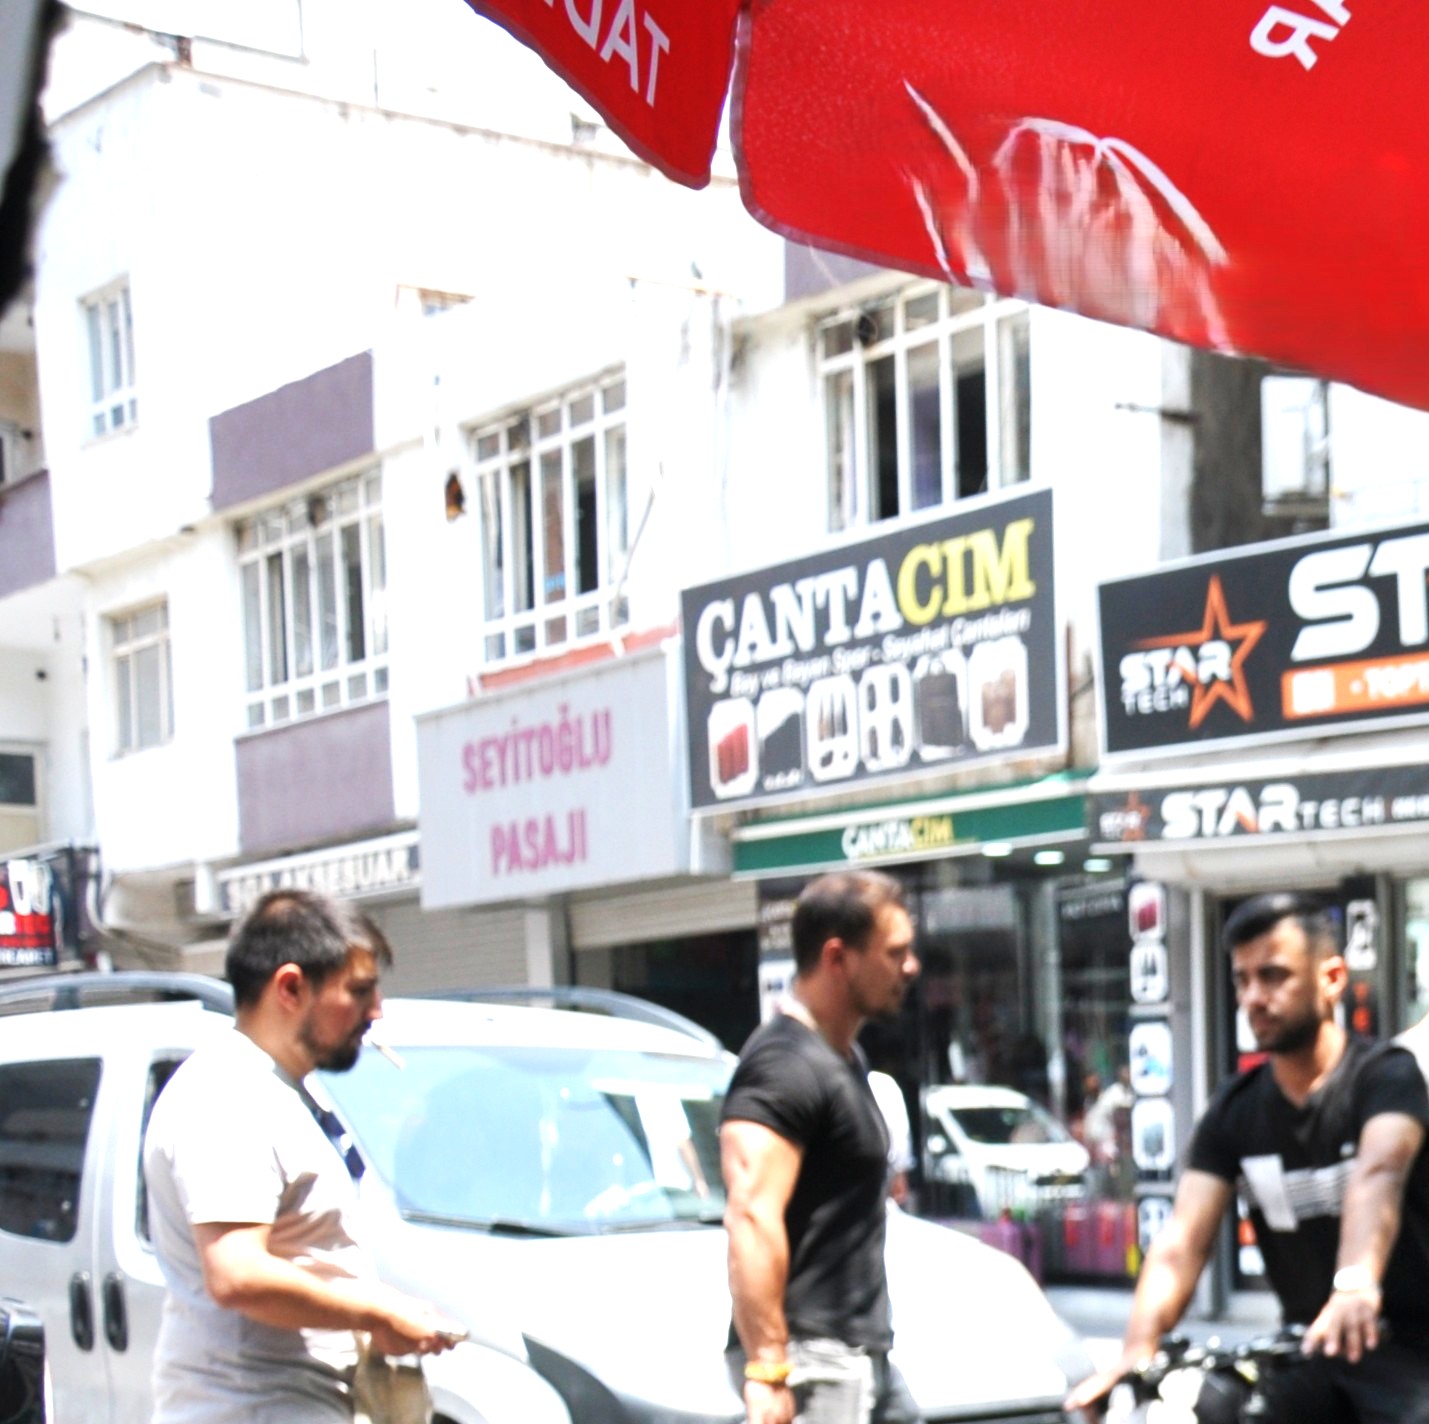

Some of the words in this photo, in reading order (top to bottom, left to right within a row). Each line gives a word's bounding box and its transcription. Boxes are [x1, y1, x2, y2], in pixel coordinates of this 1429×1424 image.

[696, 516, 1036, 692] ÇANTACIM
[489, 808, 588, 876] PASAJI
[1161, 783, 1300, 840] STAR
